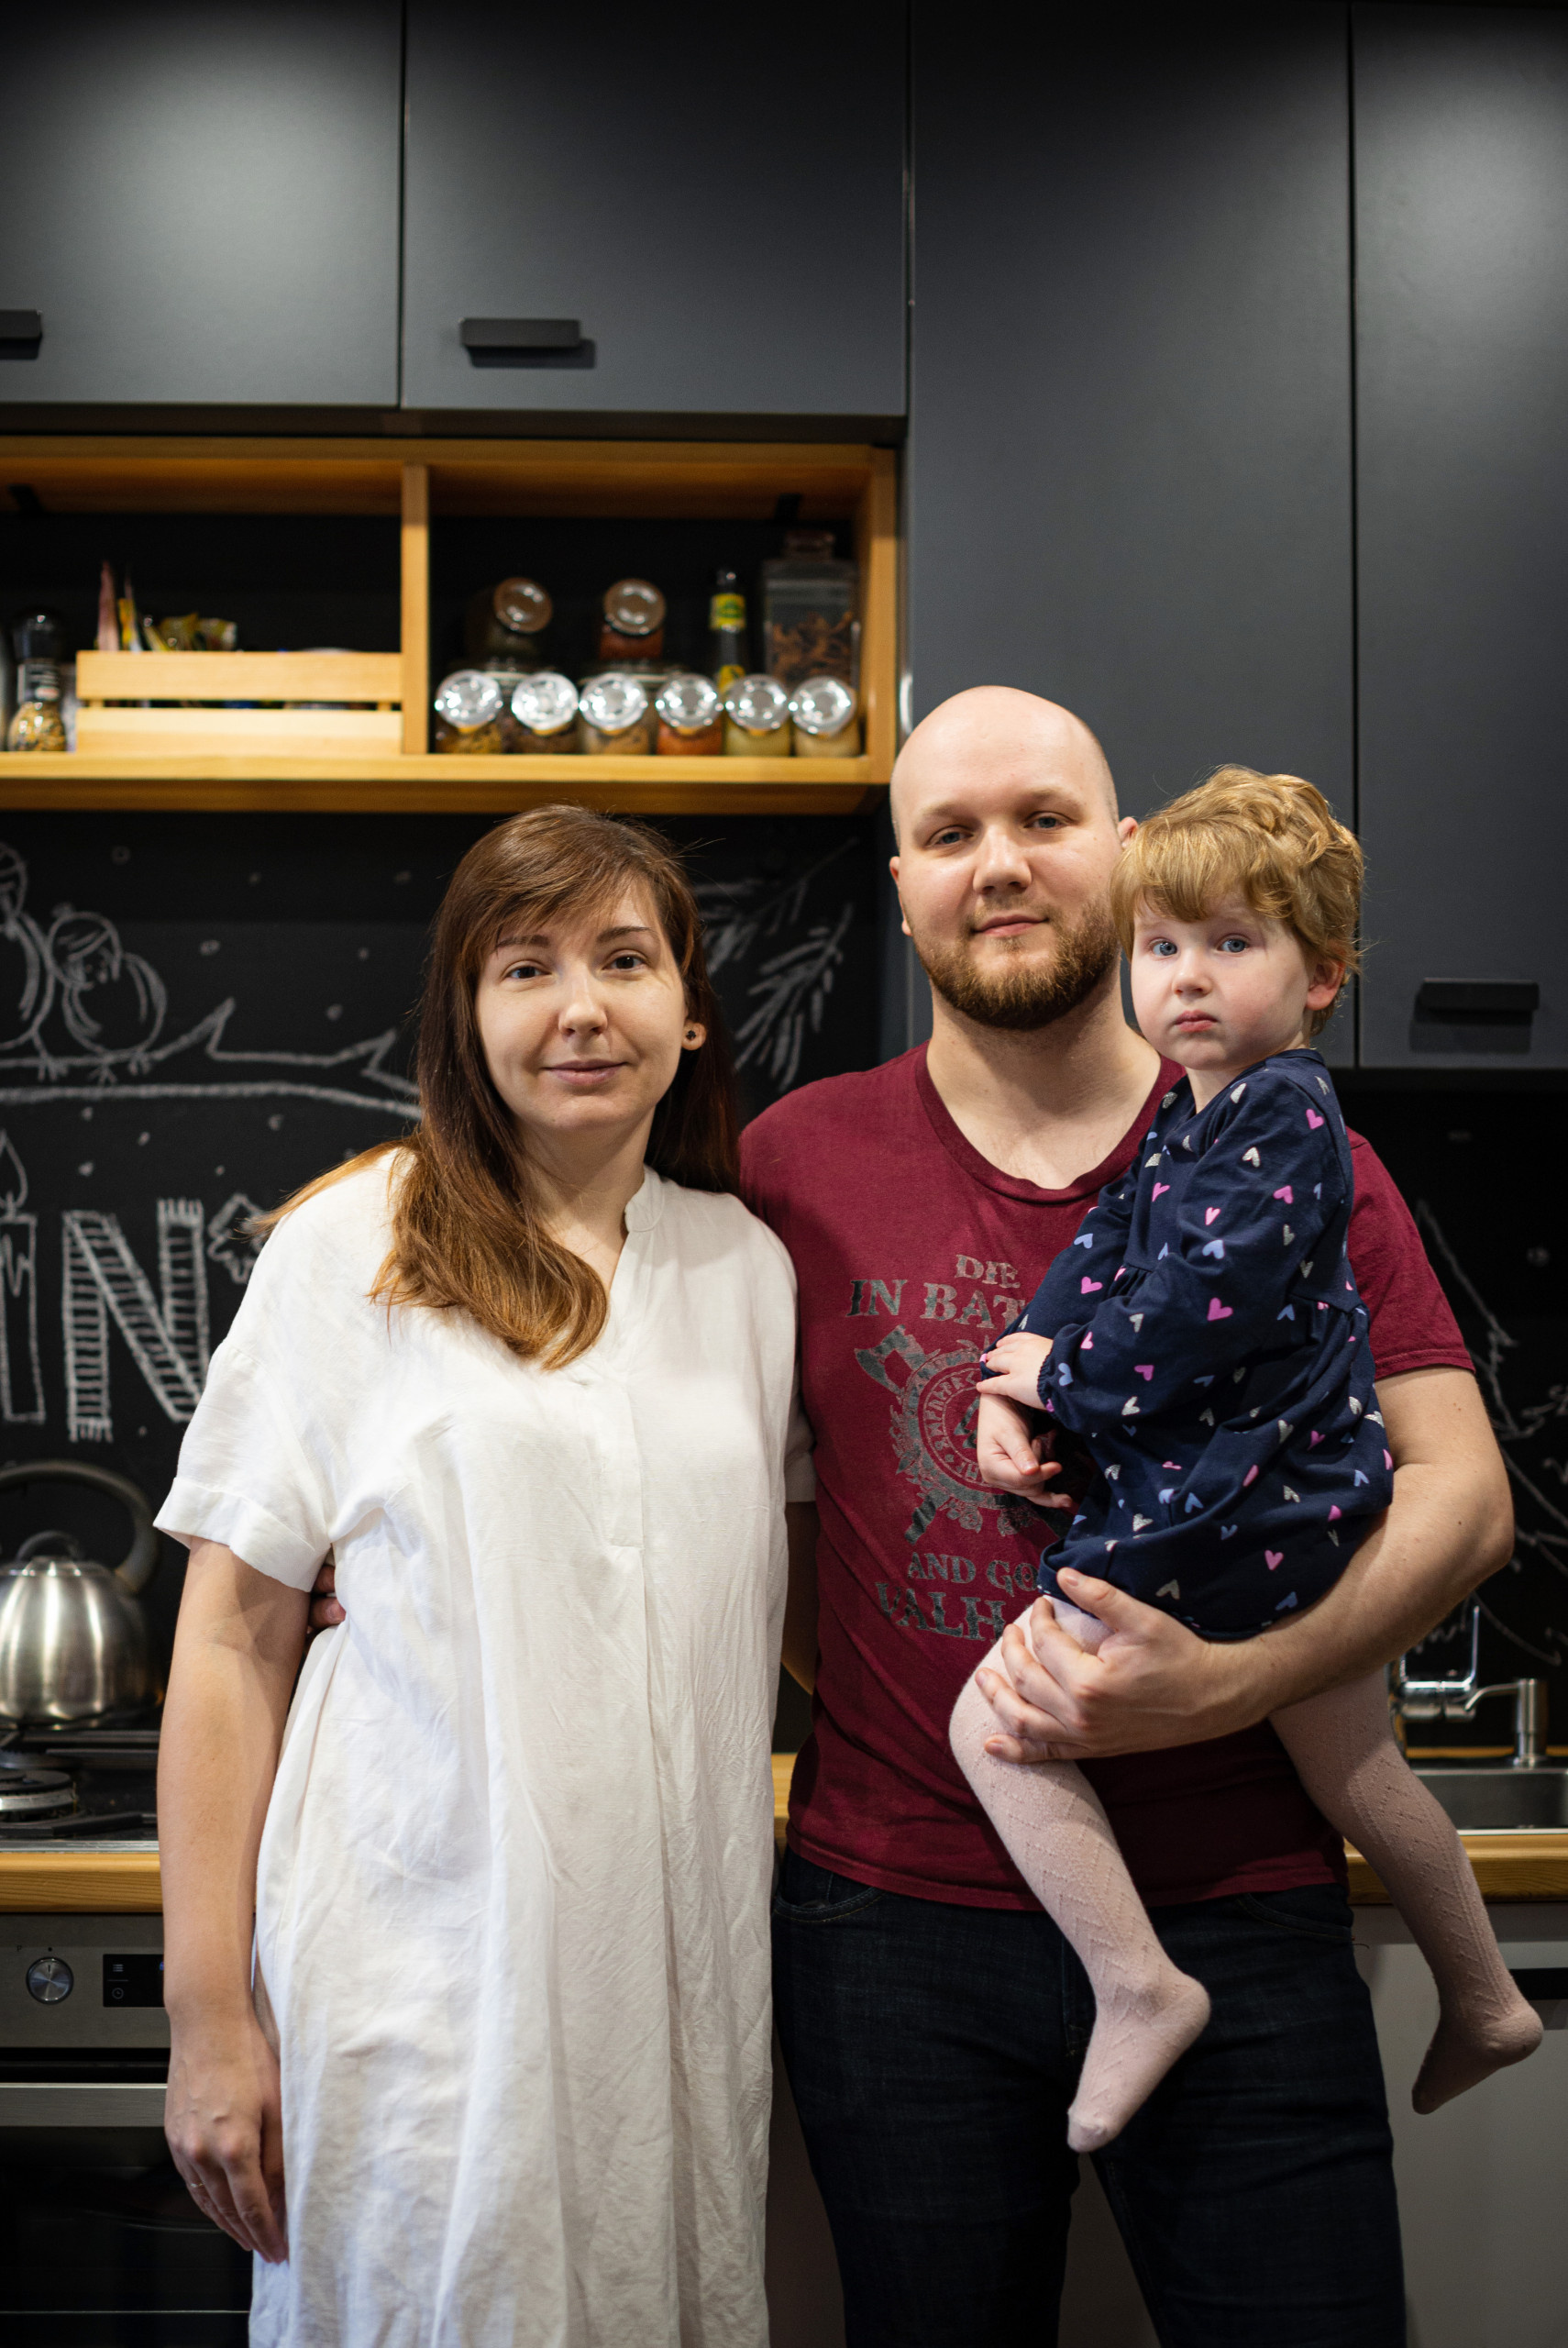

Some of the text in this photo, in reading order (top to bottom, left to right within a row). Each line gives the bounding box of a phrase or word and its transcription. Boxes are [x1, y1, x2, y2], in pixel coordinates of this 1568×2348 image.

[955, 1254, 1021, 1288] DIE
[845, 1279, 908, 1317] IN
[908, 1552, 1039, 1598] AND GO
